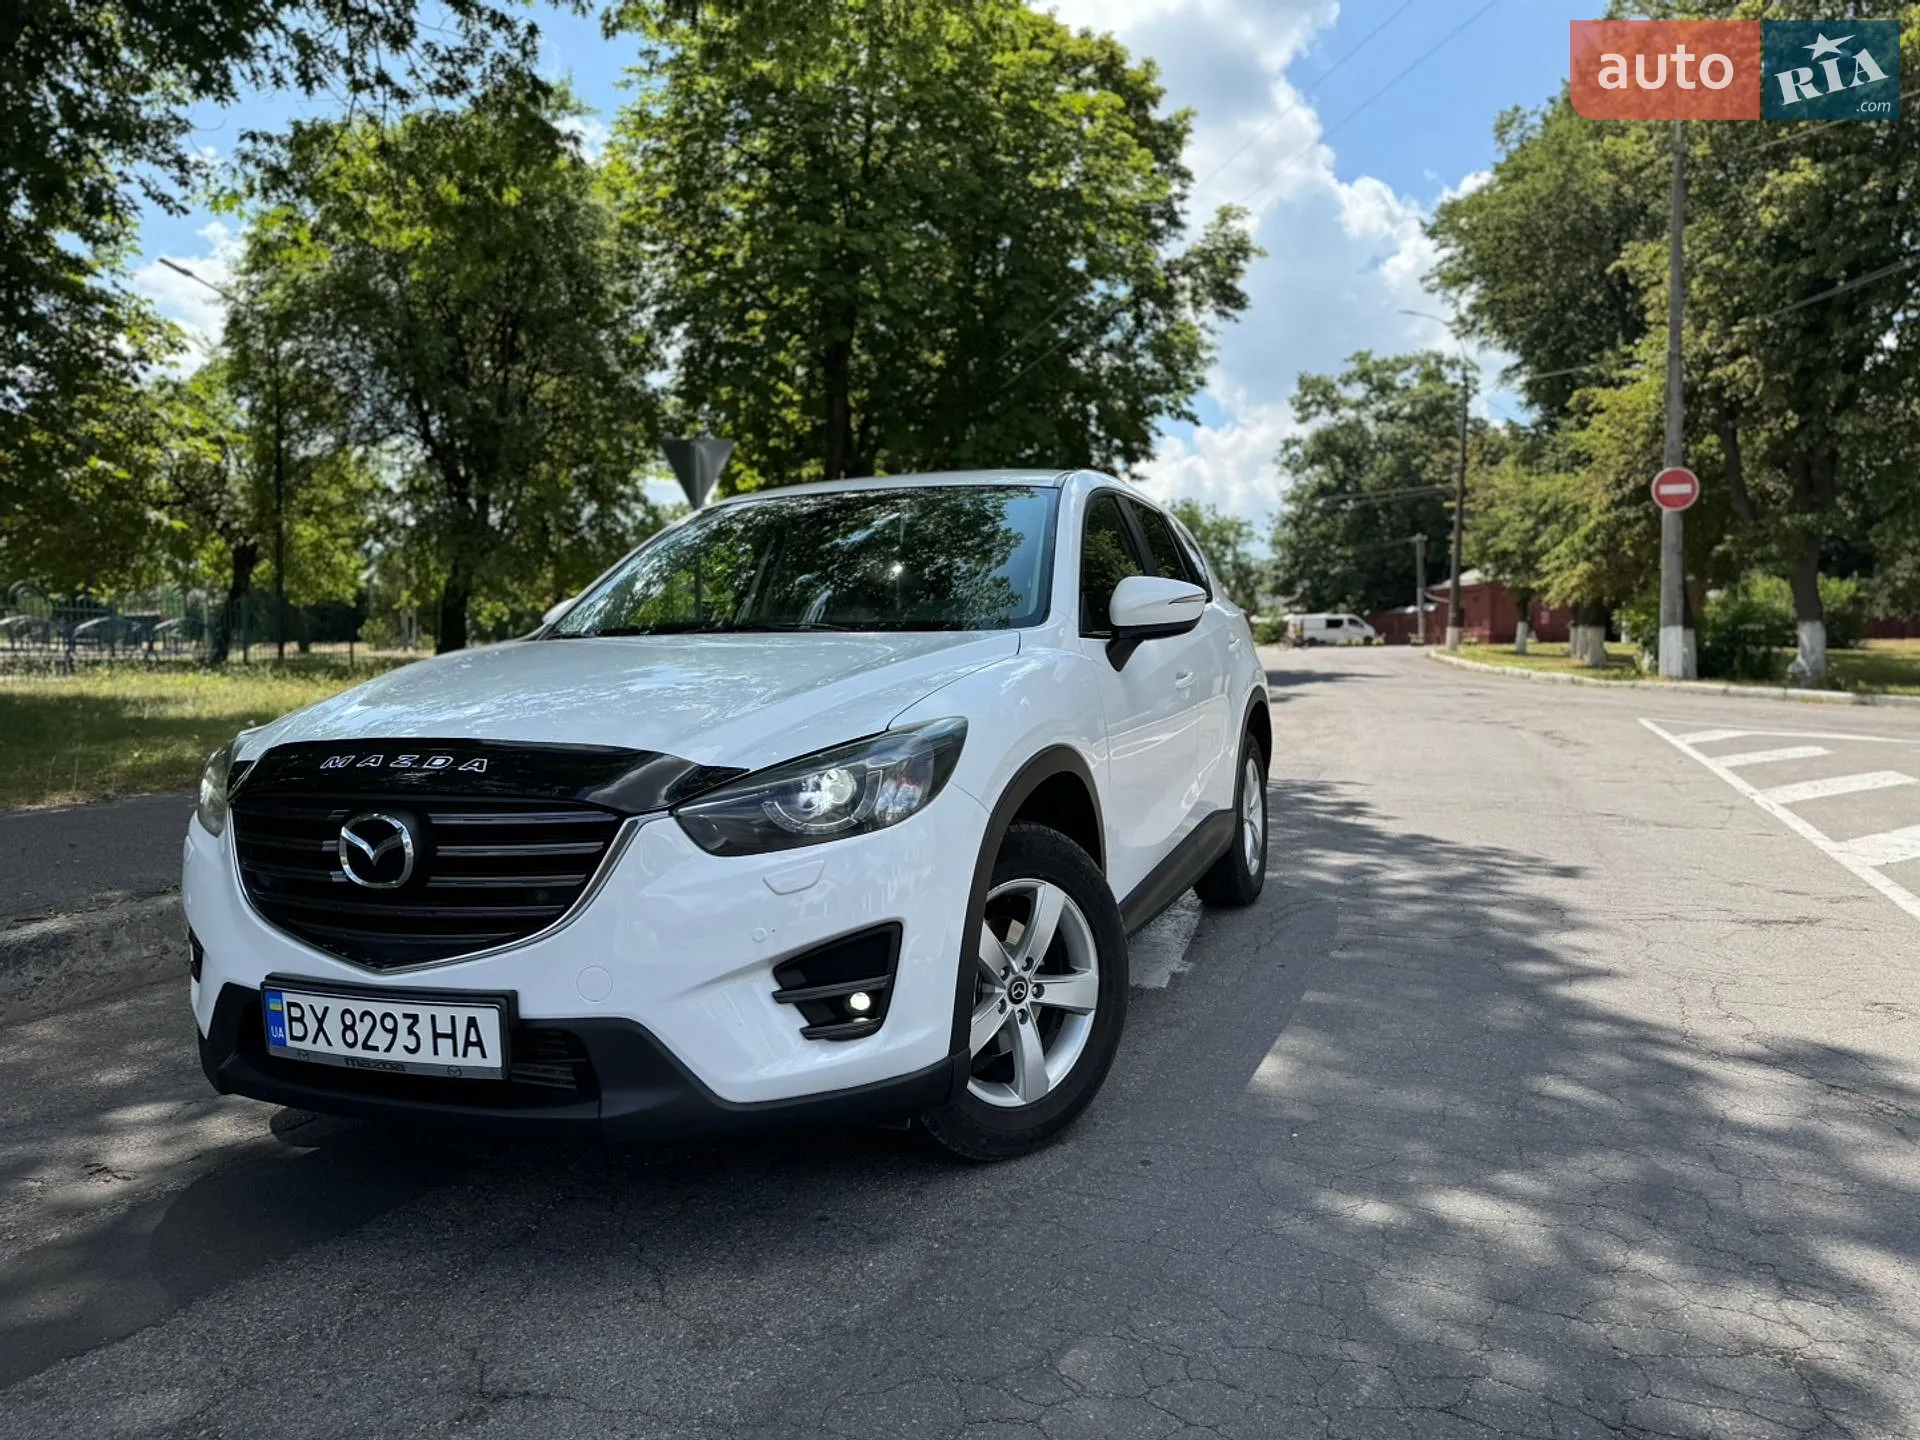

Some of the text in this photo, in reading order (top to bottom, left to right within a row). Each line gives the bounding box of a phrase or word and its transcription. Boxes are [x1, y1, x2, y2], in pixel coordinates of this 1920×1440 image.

[320, 754, 488, 772] MAZDA
[270, 1025, 286, 1039] UA
[286, 1001, 488, 1059] BX 8293 HA
